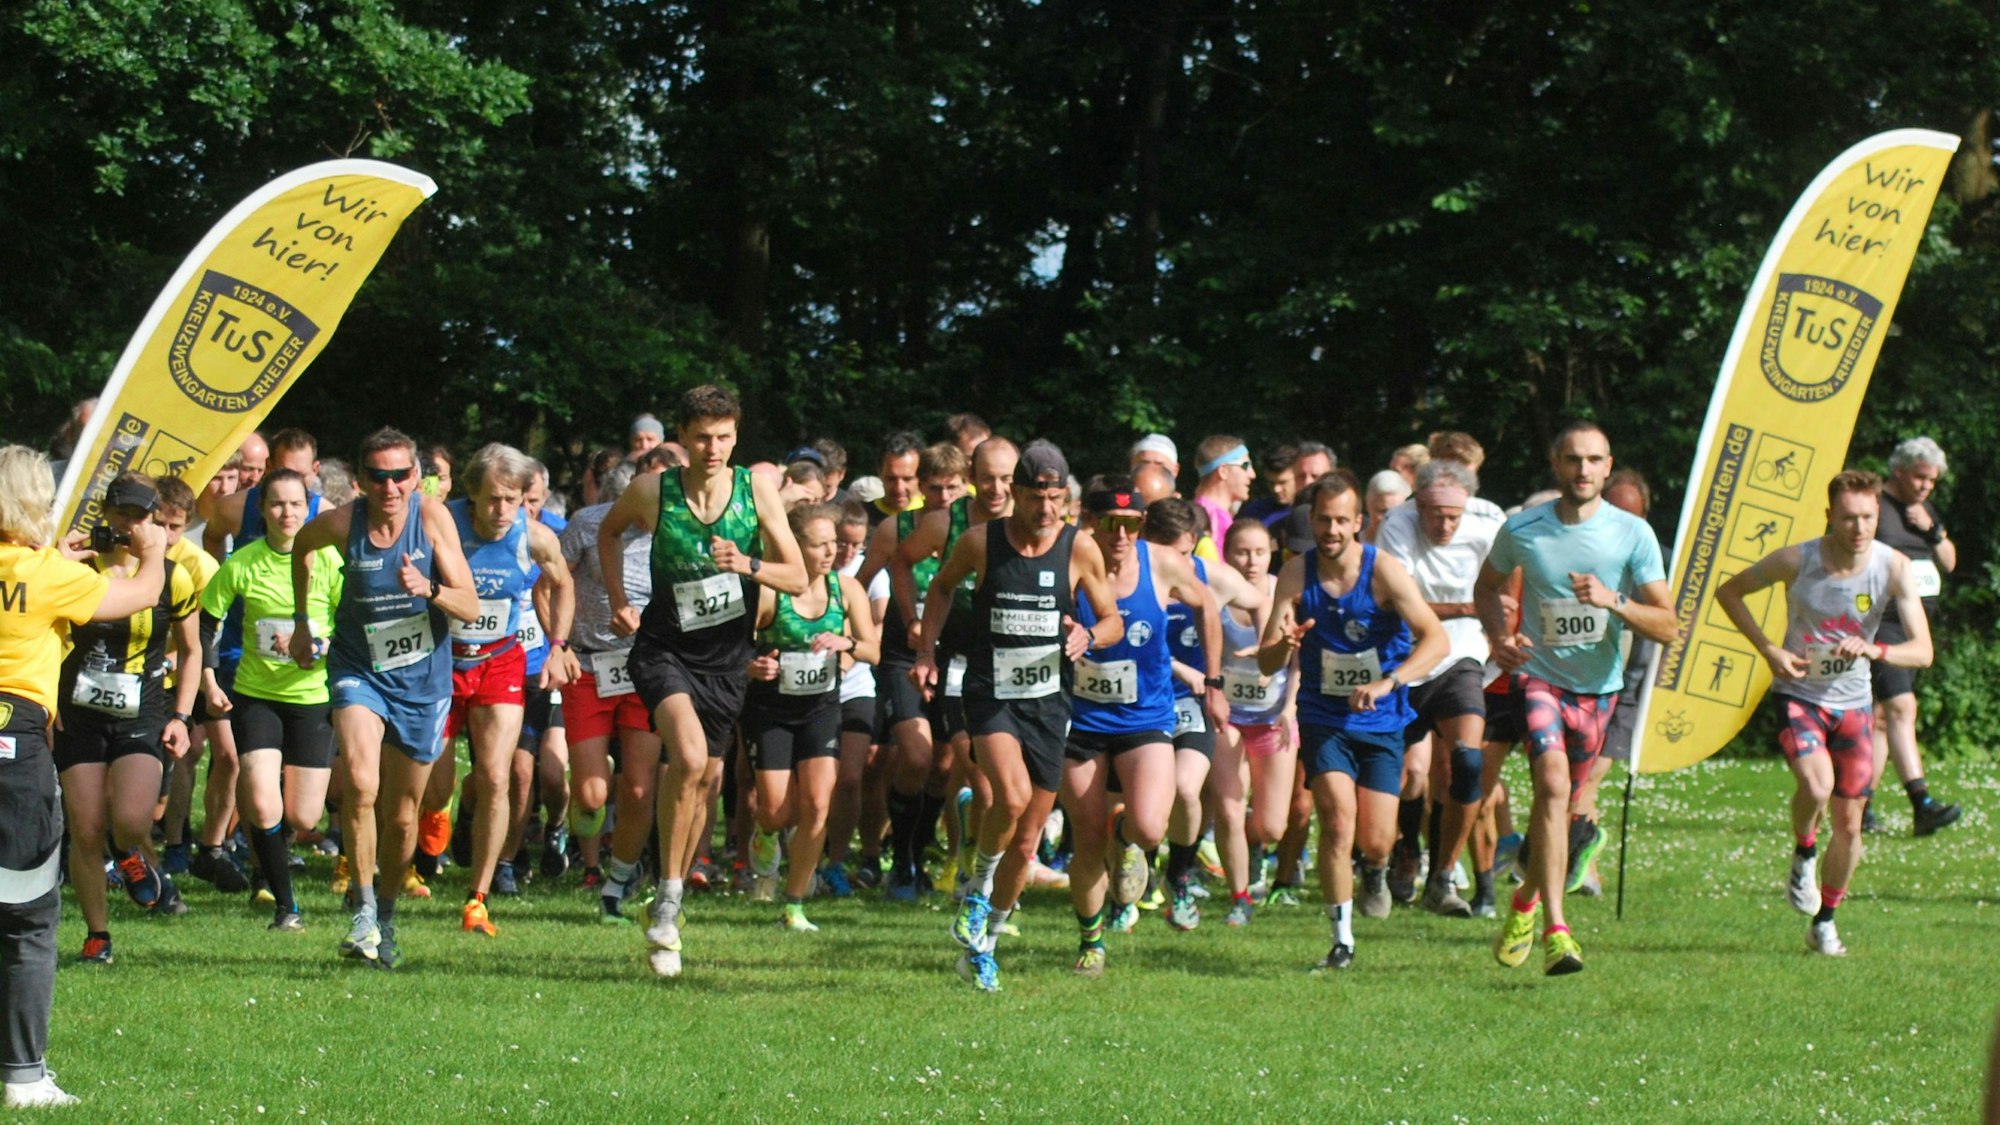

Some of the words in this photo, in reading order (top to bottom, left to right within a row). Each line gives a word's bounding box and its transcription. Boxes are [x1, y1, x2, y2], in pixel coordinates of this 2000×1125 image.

[1866, 162, 1925, 193] Wir
[323, 183, 388, 224] Wir
[1848, 197, 1902, 225] von
[297, 212, 354, 252] von
[1815, 219, 1892, 258] hier!
[252, 227, 340, 281] hier!
[233, 285, 267, 307] 1924
[266, 301, 293, 323] e.V.
[1804, 280, 1835, 296] 1924
[1836, 289, 1859, 306] e.V.
[210, 309, 274, 363] TuS
[1794, 305, 1847, 350] TuS
[694, 591, 730, 617] 327
[516, 627, 536, 642] 98
[1006, 623, 1055, 633] COLONIA
[1556, 616, 1595, 635] 300
[385, 632, 423, 658] 297
[795, 667, 828, 686] 305
[1012, 665, 1051, 686] 350
[1087, 677, 1123, 695] 281
[1334, 669, 1371, 686] 329
[88, 688, 127, 710] 253
[1232, 683, 1267, 700] 335
